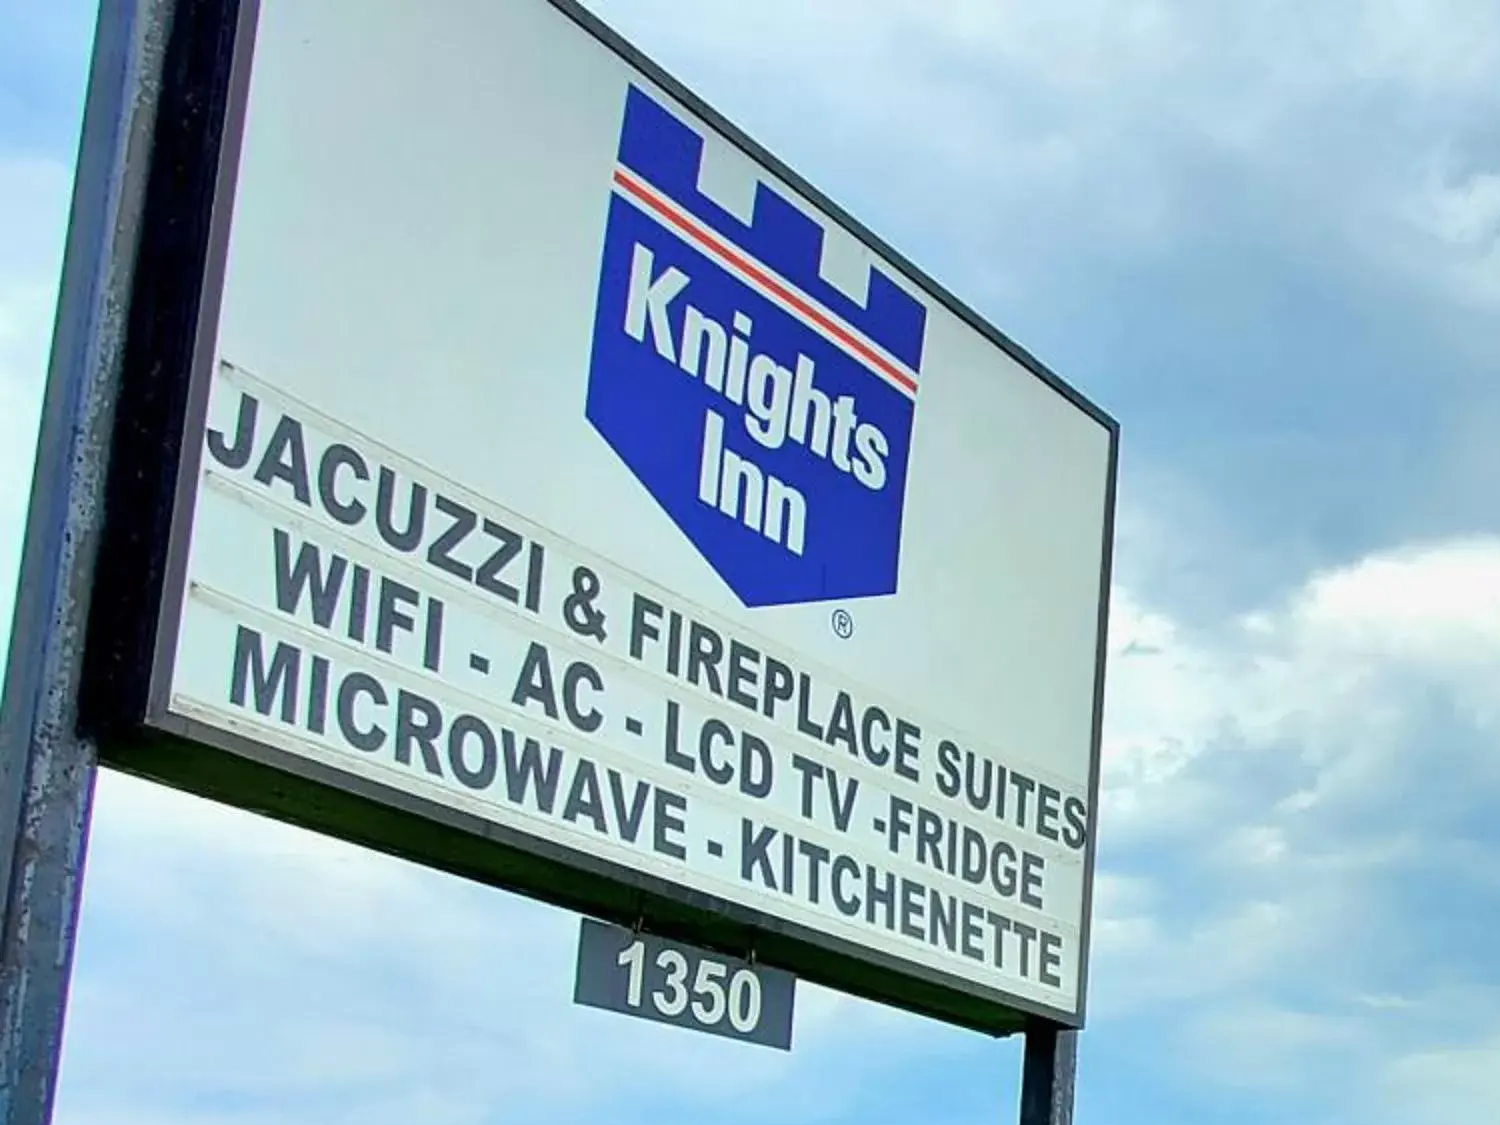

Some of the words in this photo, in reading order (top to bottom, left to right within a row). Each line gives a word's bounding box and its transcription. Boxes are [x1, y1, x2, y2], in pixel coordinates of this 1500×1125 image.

[623, 241, 889, 491] Knights
[698, 408, 807, 556] Inn
[206, 392, 545, 614] JACUZZI
[563, 565, 607, 643] &
[629, 592, 921, 783] FIREPLACE
[935, 739, 1087, 849] SUITES
[273, 527, 444, 673] WIFI
[511, 641, 604, 733] AC
[665, 699, 773, 799] LCD
[792, 753, 859, 833] TV
[229, 624, 687, 861] MICROWAVE
[741, 817, 1062, 988] KITCHENETTE
[617, 941, 762, 1033] 1350
